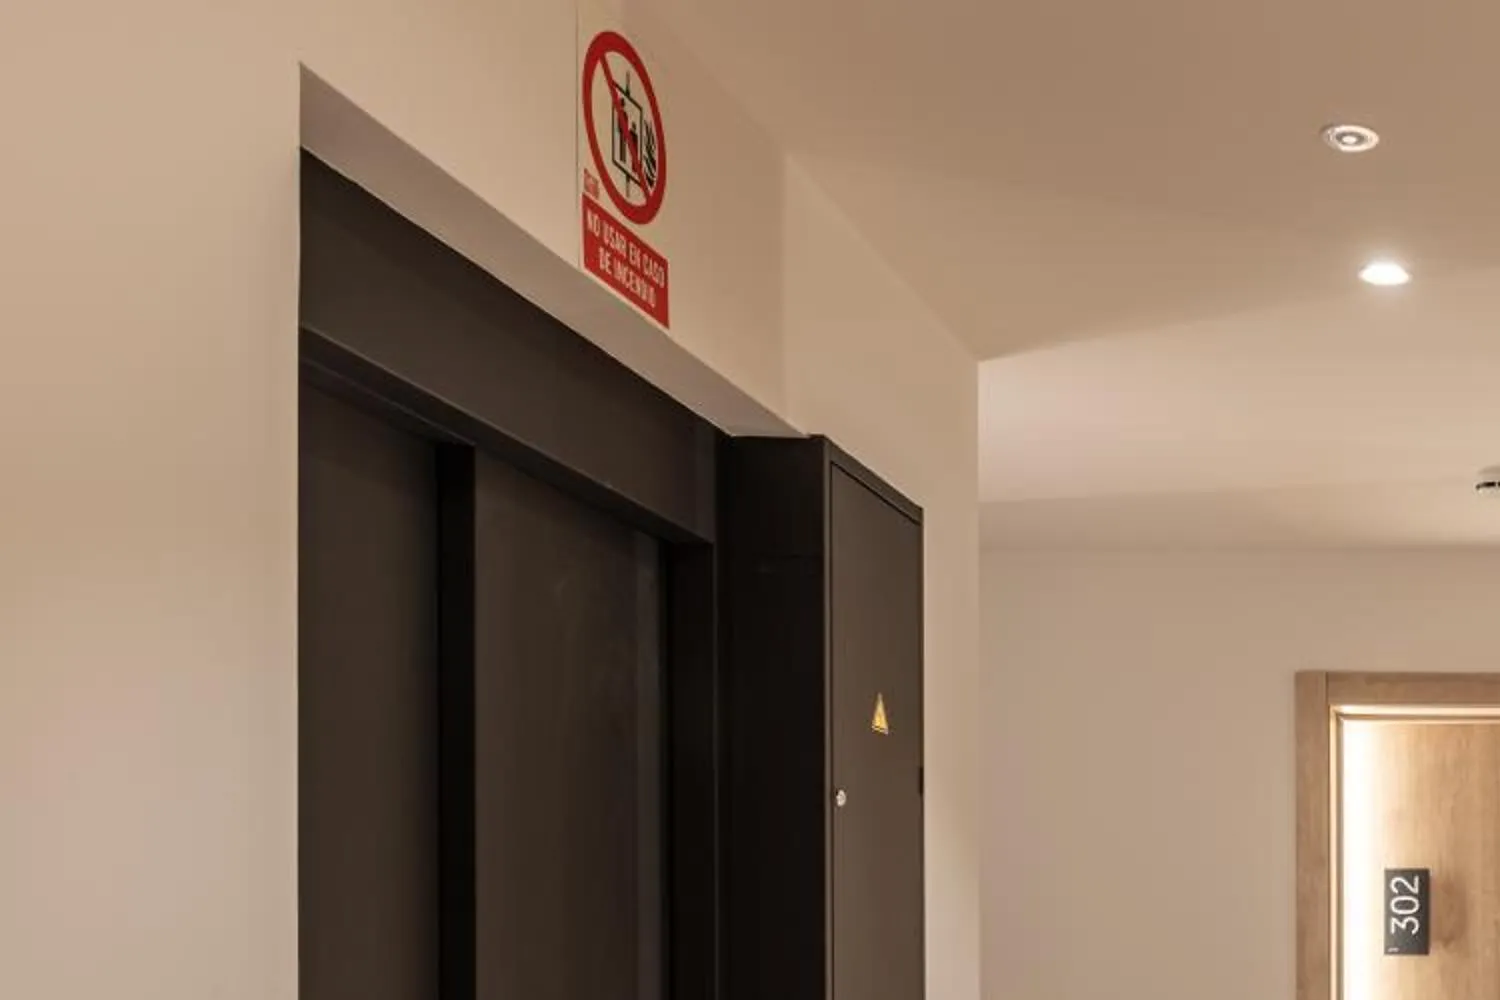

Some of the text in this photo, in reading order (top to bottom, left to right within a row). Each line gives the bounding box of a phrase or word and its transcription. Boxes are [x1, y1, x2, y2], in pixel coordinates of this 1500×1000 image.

[586, 208, 665, 289] NO USAR EN CASO
[599, 246, 656, 309] DE INCENDIO
[1389, 875, 1420, 935] 302
